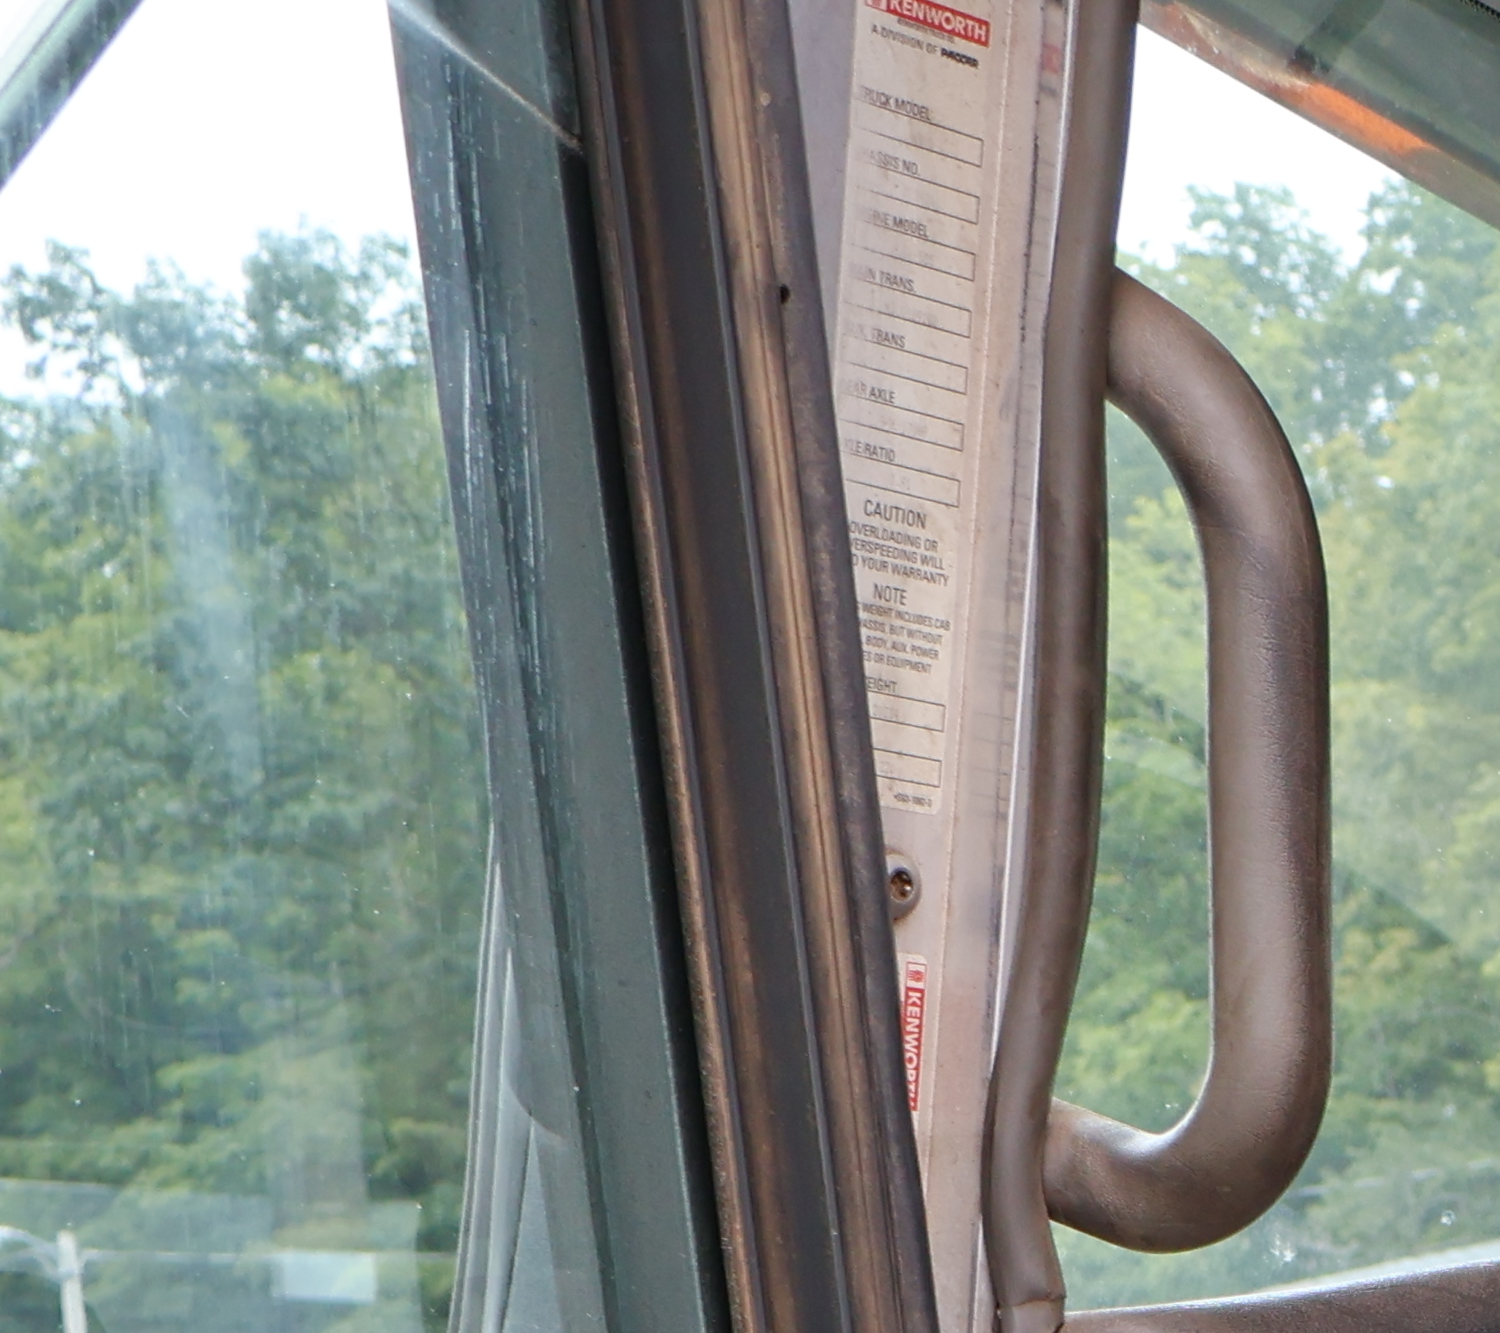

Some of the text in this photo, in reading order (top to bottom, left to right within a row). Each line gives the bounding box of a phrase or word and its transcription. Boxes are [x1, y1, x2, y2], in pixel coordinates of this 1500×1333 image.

[888, 0, 988, 42] KENWORTH
[894, 97, 931, 122] MODEL
[892, 216, 929, 239] MODEL
[868, 387, 897, 404] AXLE
[863, 442, 896, 463] RATIO
[863, 499, 929, 530] CAUTION
[849, 521, 939, 553] OVERLOADING OR
[850, 538, 919, 565] VERSPEEDING
[920, 555, 946, 571] WILL
[861, 556, 889, 572] YOUR
[891, 562, 950, 588] WARRANTY
[872, 583, 908, 607] NOTE
[894, 607, 933, 628] INCLUDES
[906, 627, 943, 646] WITHOUT
[910, 644, 940, 661] POWER
[886, 655, 933, 675] EQUIPMENT
[866, 675, 898, 694] EIGHT
[904, 991, 923, 1110] KENWOR
